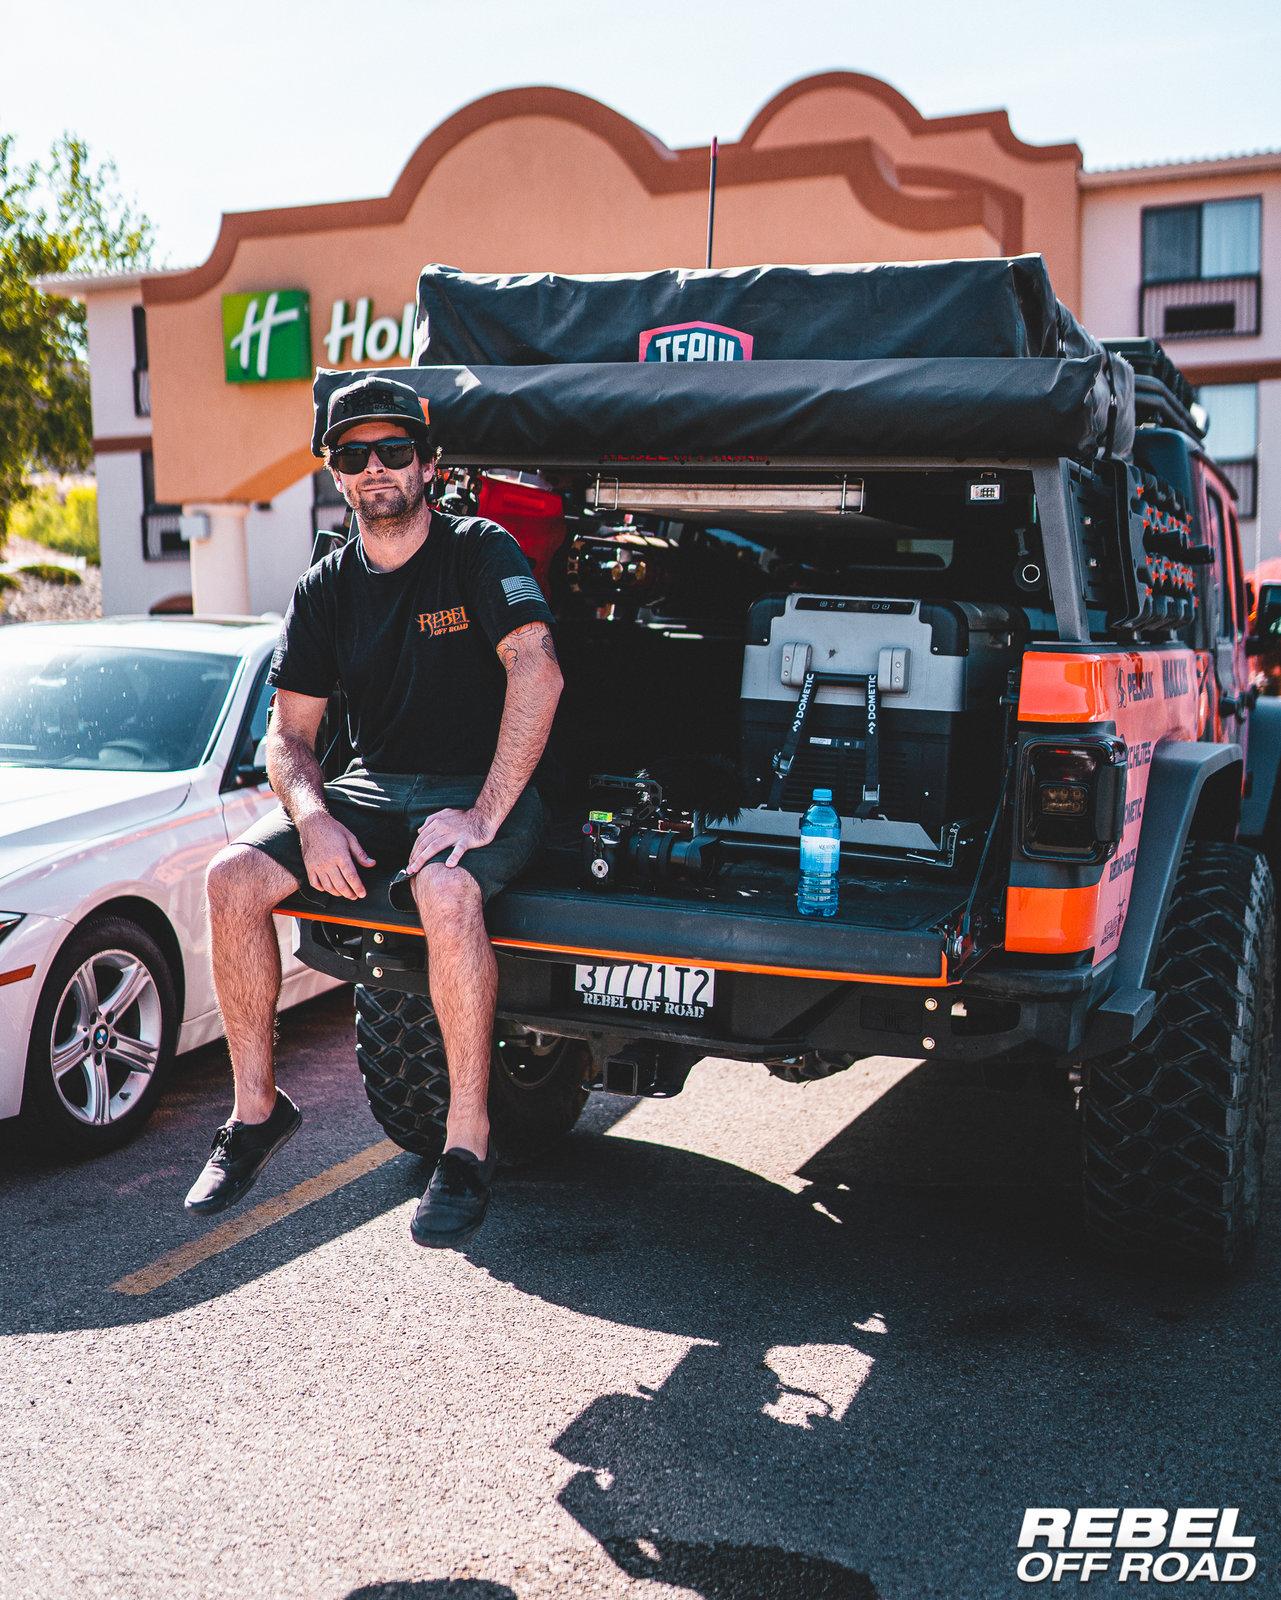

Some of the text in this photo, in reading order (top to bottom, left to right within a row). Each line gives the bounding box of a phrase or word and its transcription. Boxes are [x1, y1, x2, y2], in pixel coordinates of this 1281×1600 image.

[415, 606, 470, 638] REBEL
[434, 623, 469, 636] OFF ROAD
[796, 673, 815, 719] DOMETIC
[868, 674, 876, 720] DOMETIC
[583, 992, 705, 1018] REBEL OFF ROAD
